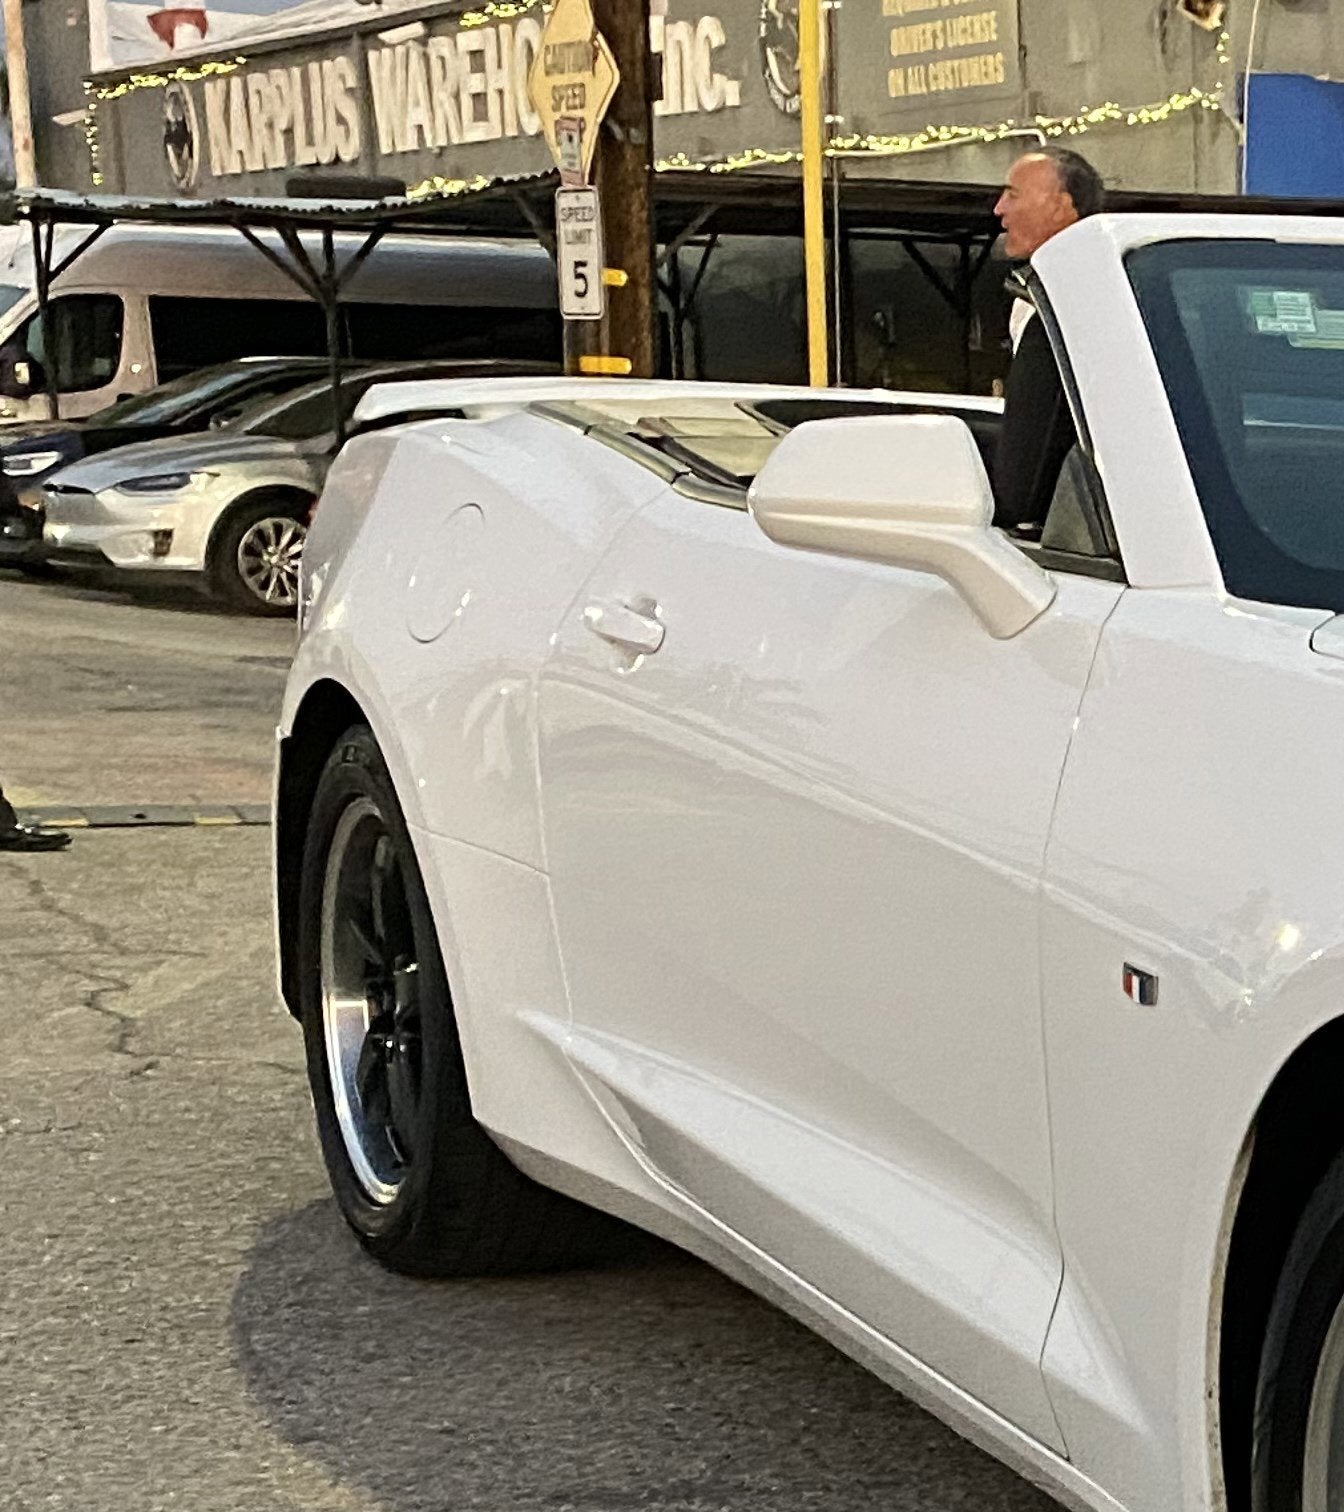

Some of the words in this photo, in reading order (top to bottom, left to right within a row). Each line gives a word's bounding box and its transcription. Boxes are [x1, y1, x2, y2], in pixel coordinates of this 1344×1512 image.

[888, 68, 904, 97] ON
[928, 52, 1004, 91] CUSTOMERS
[204, 56, 360, 176] KARPLUS
[560, 205, 593, 222] SPEED
[573, 260, 589, 298] 5
